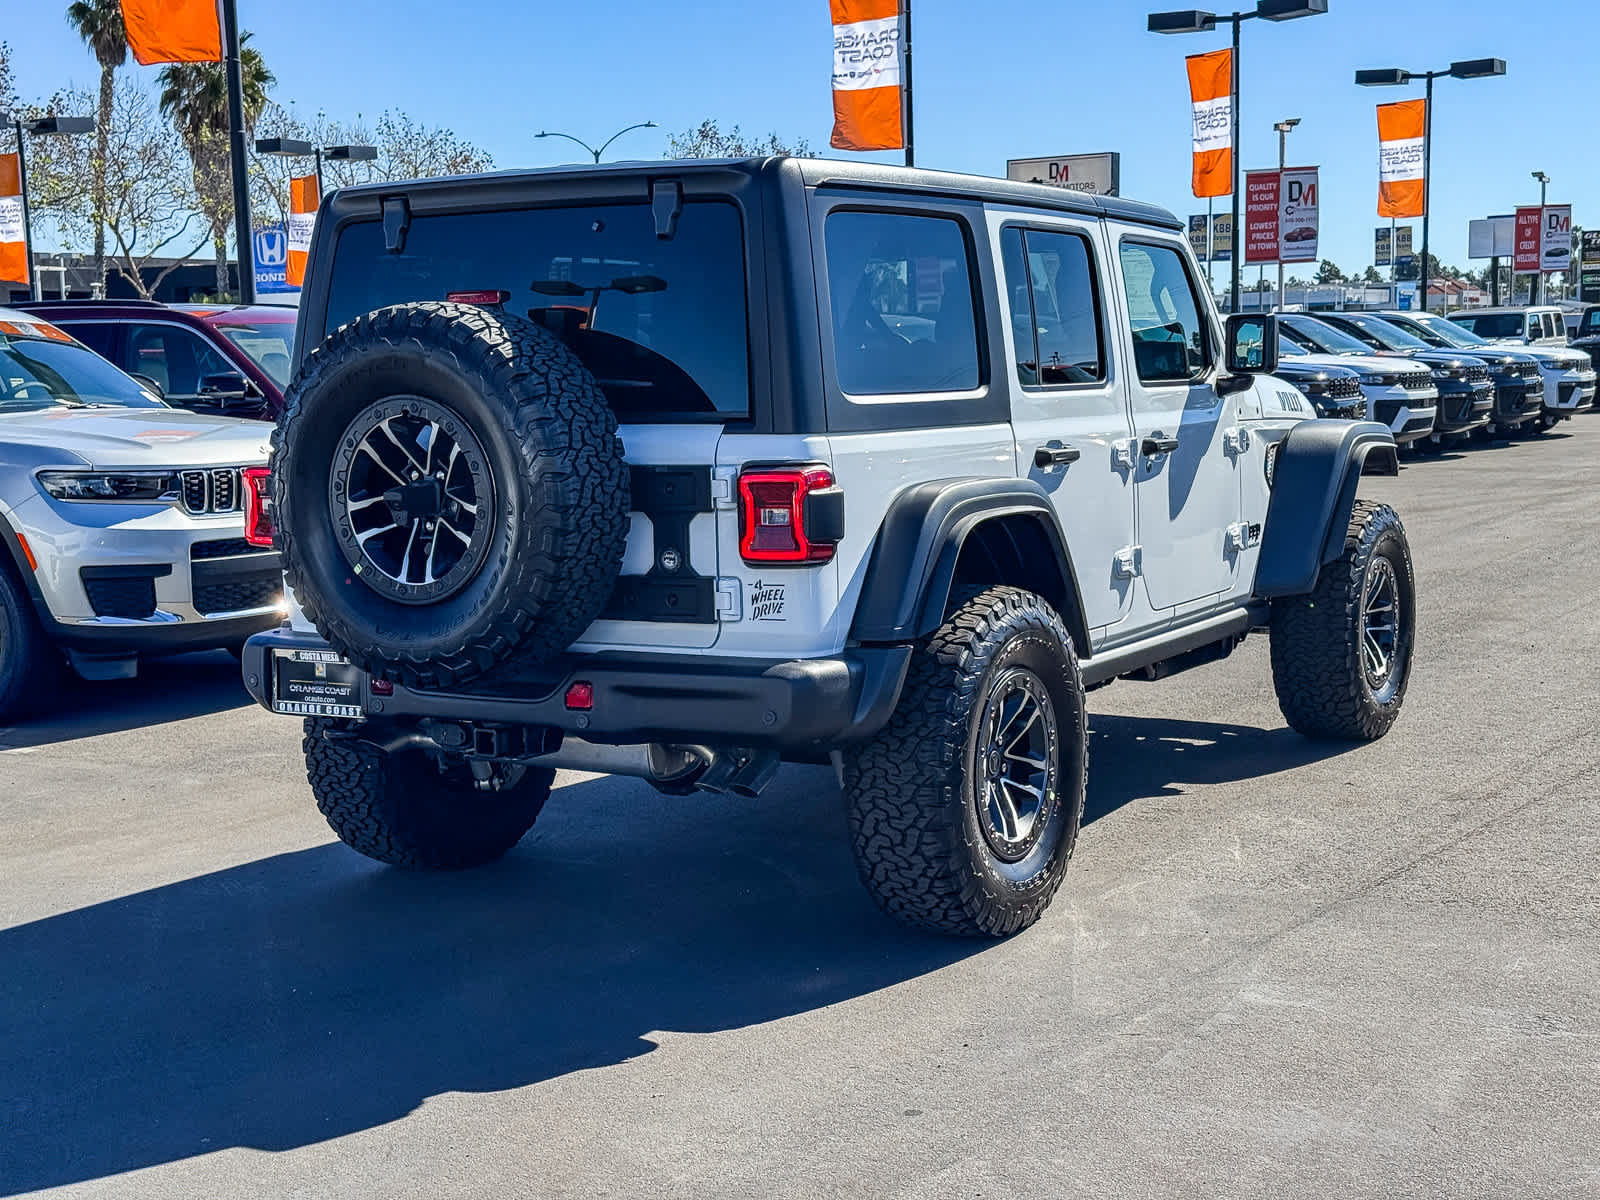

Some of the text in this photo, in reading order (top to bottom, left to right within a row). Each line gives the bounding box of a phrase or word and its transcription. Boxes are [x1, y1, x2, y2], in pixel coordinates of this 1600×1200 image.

[1249, 183, 1277, 191] QUALITY
[1252, 193, 1259, 201] IS
[1248, 203, 1278, 211] PRIORITY
[1249, 222, 1277, 230] LOWEST
[1252, 232, 1274, 240] PRICES
[1257, 242, 1277, 250] TOWN
[754, 579, 763, 590] 4
[752, 589, 785, 606] WHEEL
[752, 602, 785, 621] DRIVE
[299, 652, 340, 662] COSTA MESA
[289, 684, 352, 696] ORANGE COAST
[279, 702, 362, 717] ORANGE COAST
